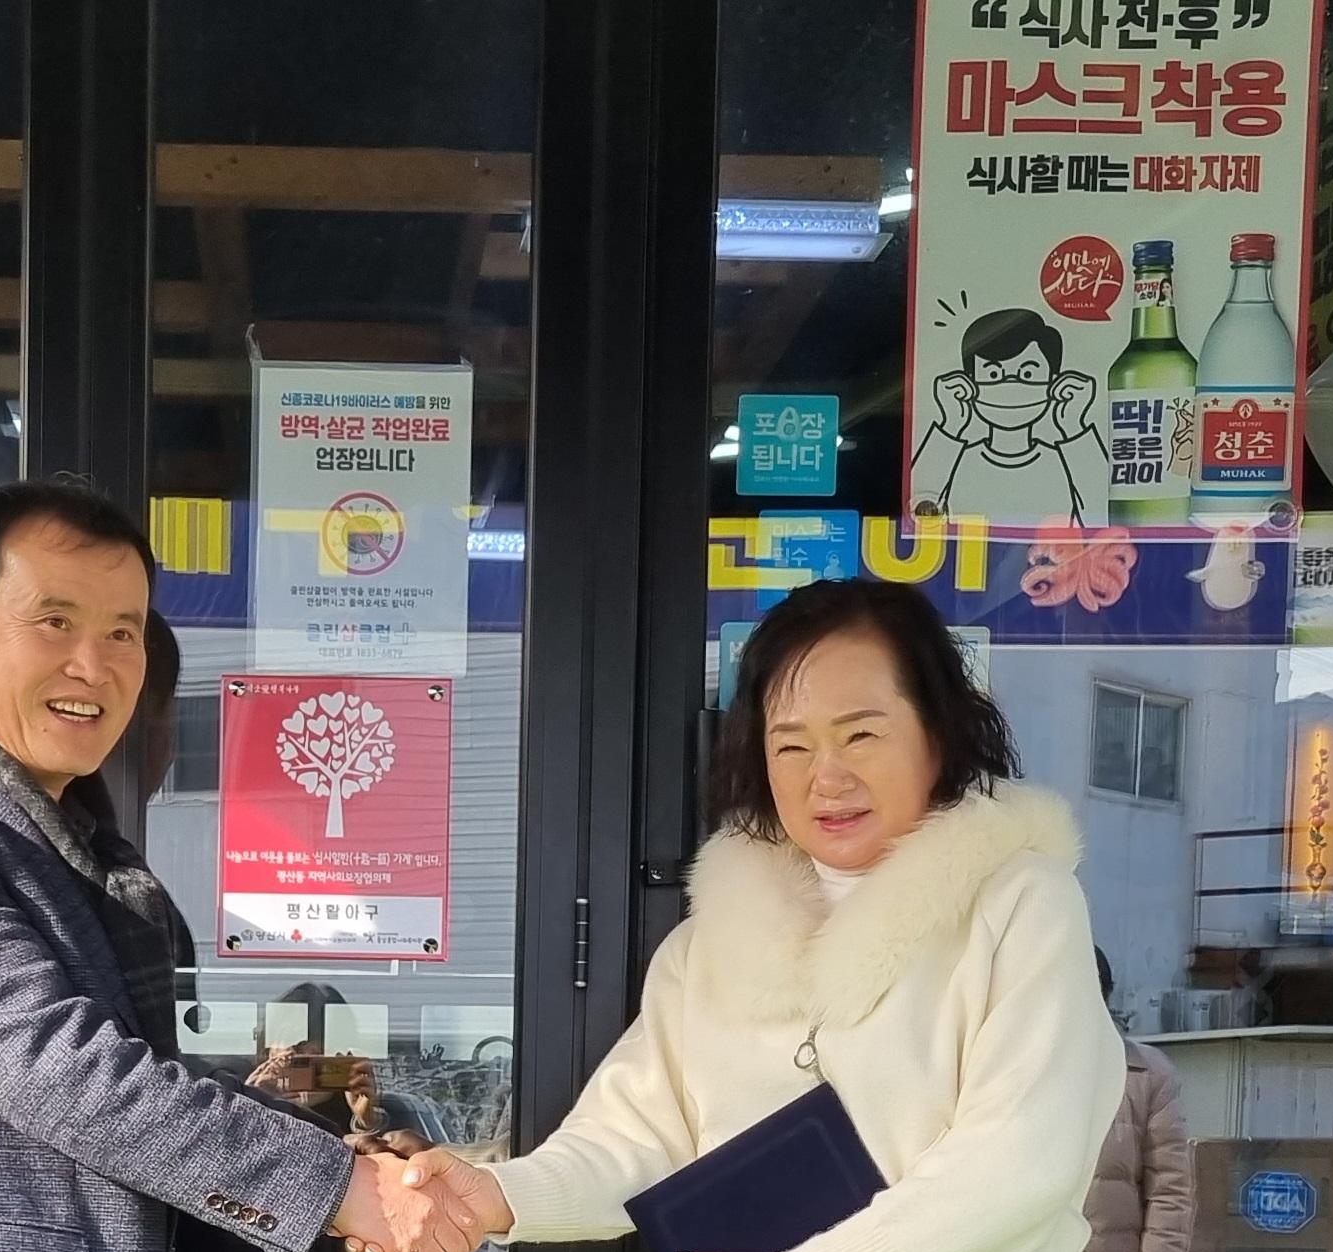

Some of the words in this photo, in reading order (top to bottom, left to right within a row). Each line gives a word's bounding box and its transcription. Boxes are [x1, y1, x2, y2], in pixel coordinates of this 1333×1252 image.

[967, 154, 1063, 195] 식사할
[1067, 155, 1129, 193] 때는
[1134, 155, 1197, 193] 대화
[1198, 155, 1261, 193] 자제
[429, 396, 451, 410] 위한
[1111, 399, 1164, 434] 딱!
[371, 417, 450, 442] 작업완료
[752, 444, 824, 471] 됩니다
[1111, 437, 1163, 460] 좋은
[1213, 431, 1275, 460] 청춘
[316, 447, 415, 472] 업장입니다
[1111, 462, 1163, 485] 데이
[1220, 469, 1266, 478] MUHAK
[306, 598, 346, 608] 안심하시고
